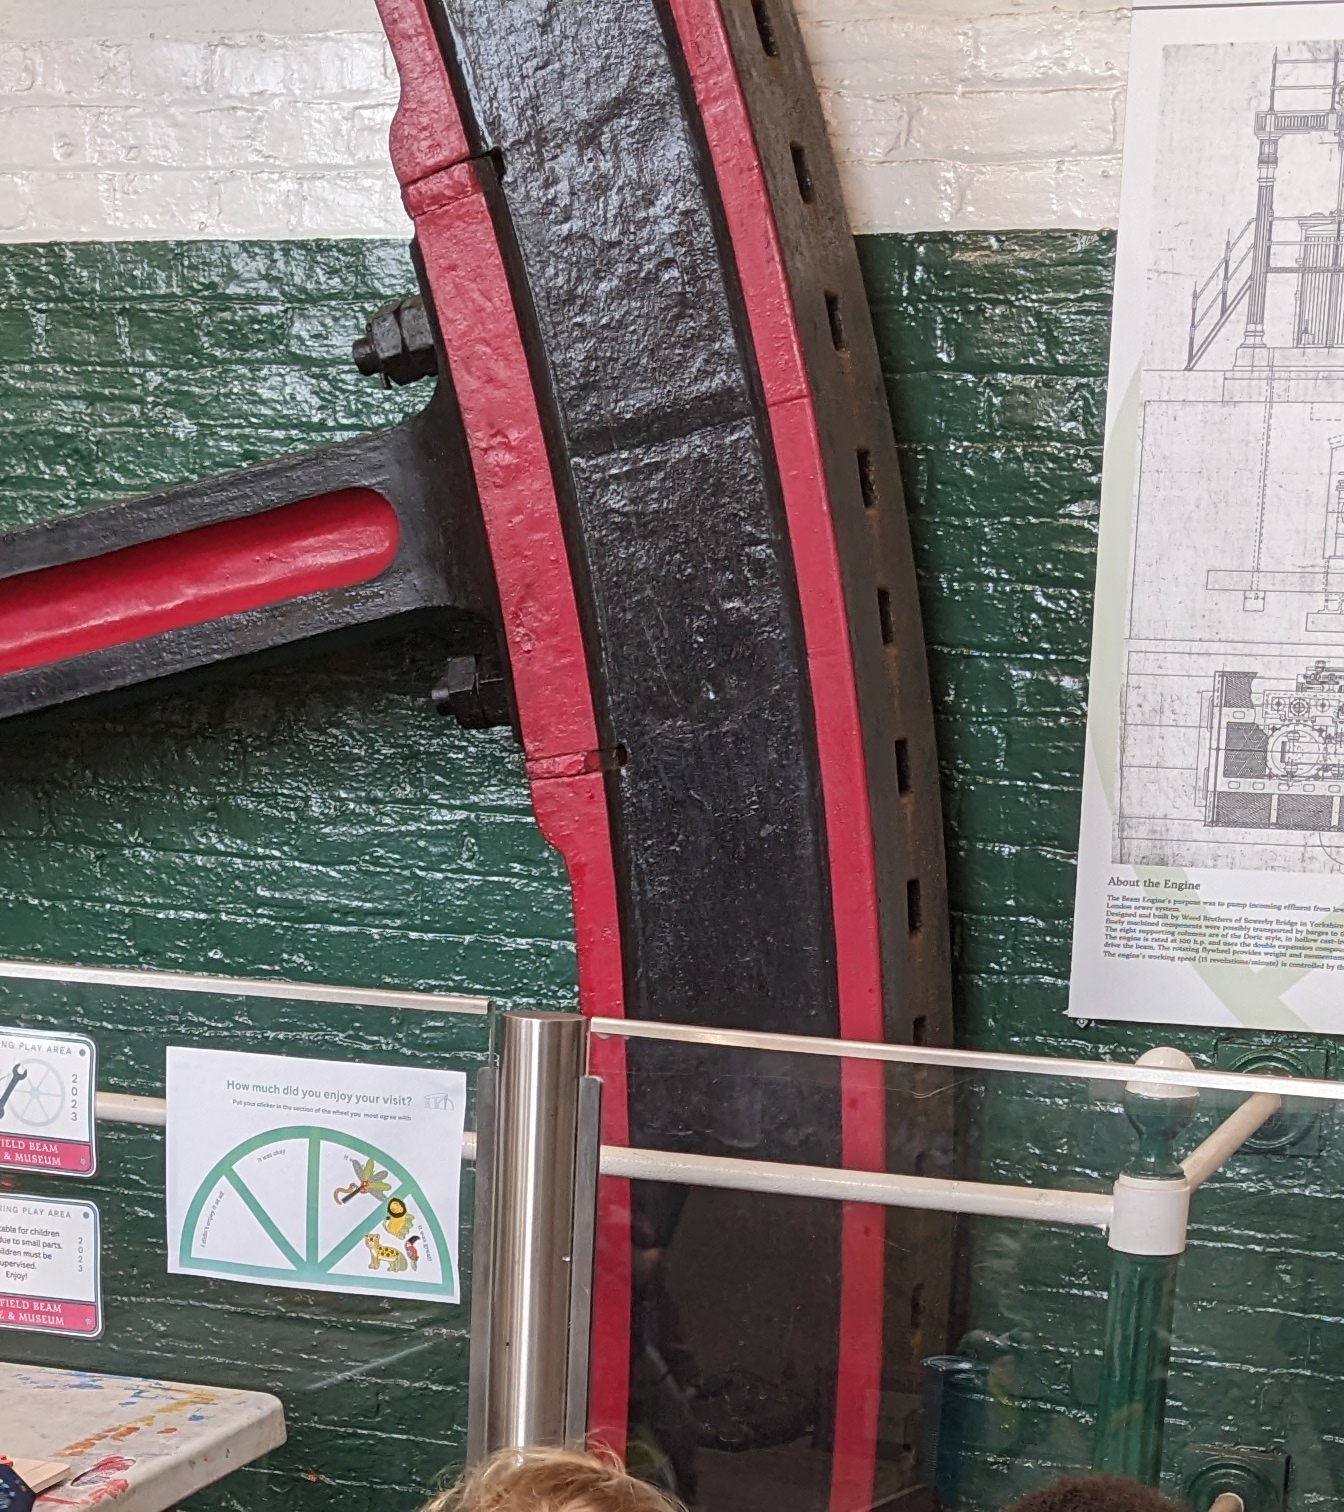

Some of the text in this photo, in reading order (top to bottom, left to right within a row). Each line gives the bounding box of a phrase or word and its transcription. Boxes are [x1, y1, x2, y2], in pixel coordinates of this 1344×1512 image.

[1107, 876, 1200, 891] About the Engine
[1121, 894, 1140, 902] Beam
[1248, 902, 1282, 911] incoming
[1283, 903, 1311, 911] effluent
[1313, 904, 1330, 912] from
[19, 1043, 42, 1052] PLAY
[47, 1046, 72, 1054] AREA
[227, 1080, 412, 1106] How much did you enjoy your visit?
[30, 1143, 58, 1153] BEAM
[4, 1152, 11, 1160] &
[15, 1153, 61, 1165] MUSEUM
[23, 1208, 44, 1216] PLAY
[207, 1211, 215, 1226] enjoy
[18, 1226, 28, 1234] for
[30, 1229, 60, 1237] children
[22, 1238, 40, 1247] small
[43, 1241, 62, 1249] parts.
[43, 1252, 52, 1260] be
[6, 1271, 28, 1280] Enjoy!
[33, 1303, 62, 1313] BEAM
[8, 1312, 15, 1320] &
[19, 1313, 64, 1325] MUSEUM
